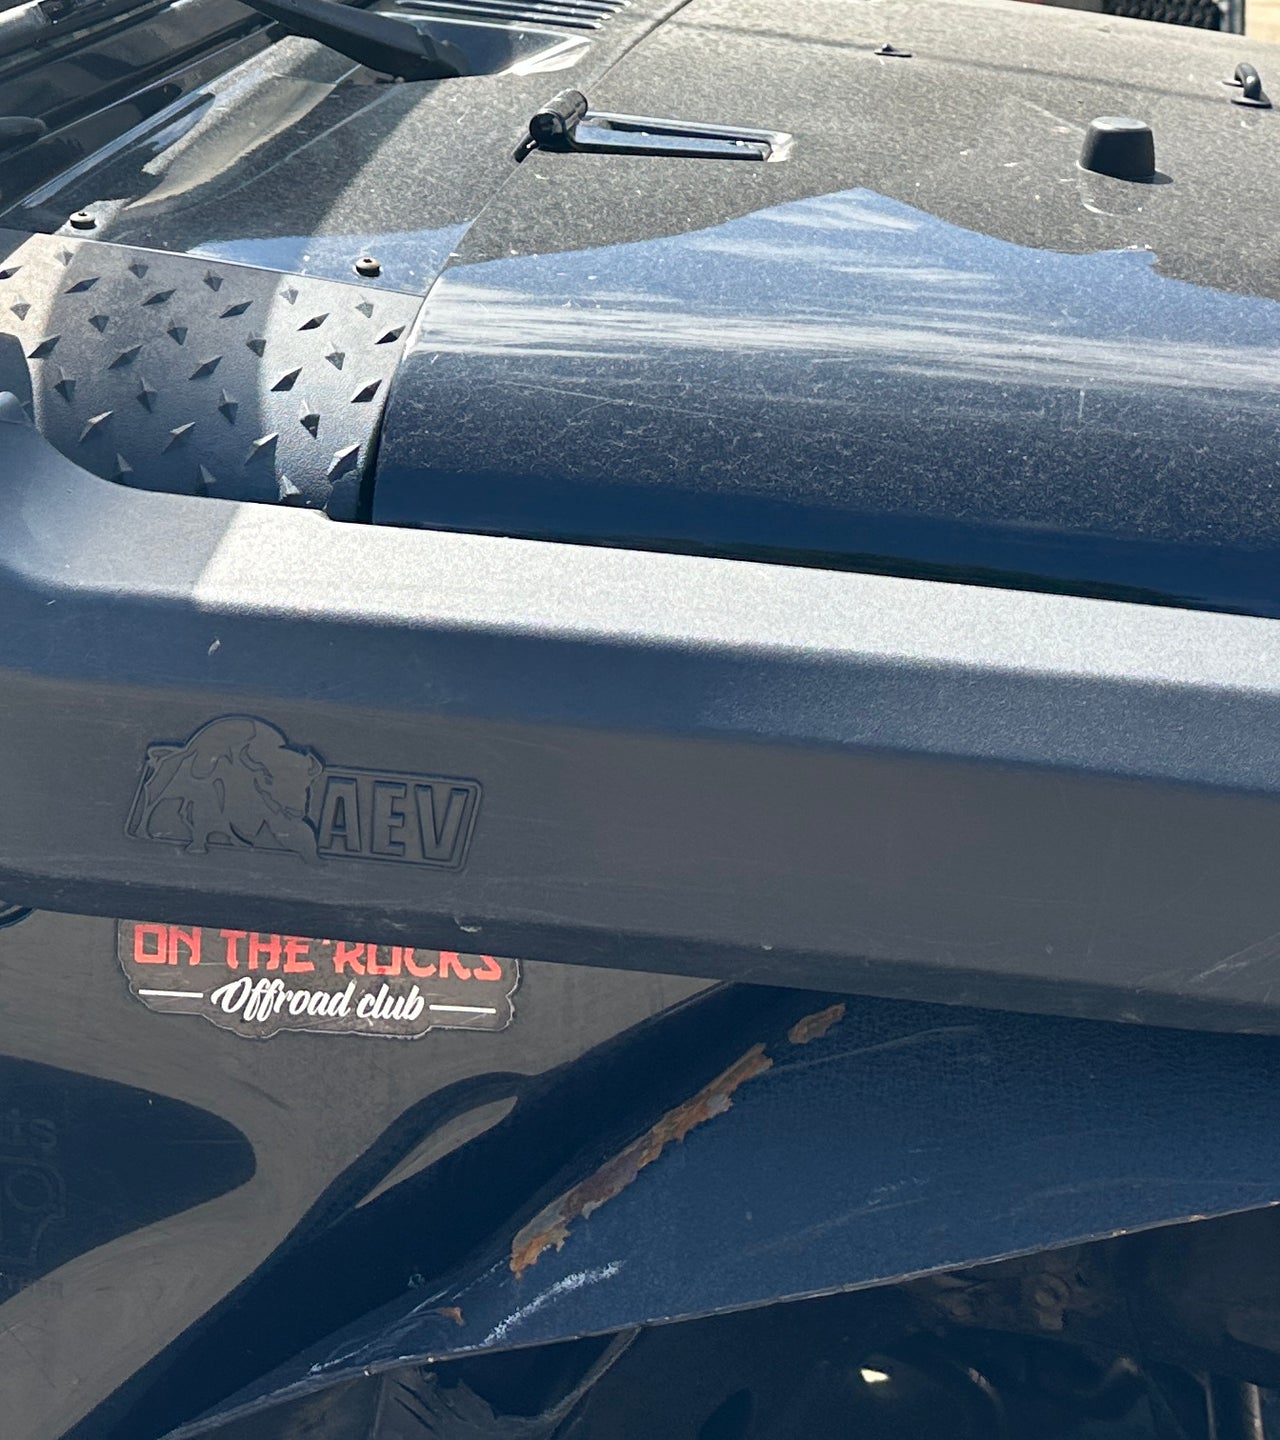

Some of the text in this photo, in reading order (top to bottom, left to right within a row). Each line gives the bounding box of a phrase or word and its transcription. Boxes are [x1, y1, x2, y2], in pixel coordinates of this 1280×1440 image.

[323, 776, 469, 860] AEV
[133, 923, 202, 965] ON
[220, 928, 315, 973] THE
[210, 975, 426, 1022] Offroad club
